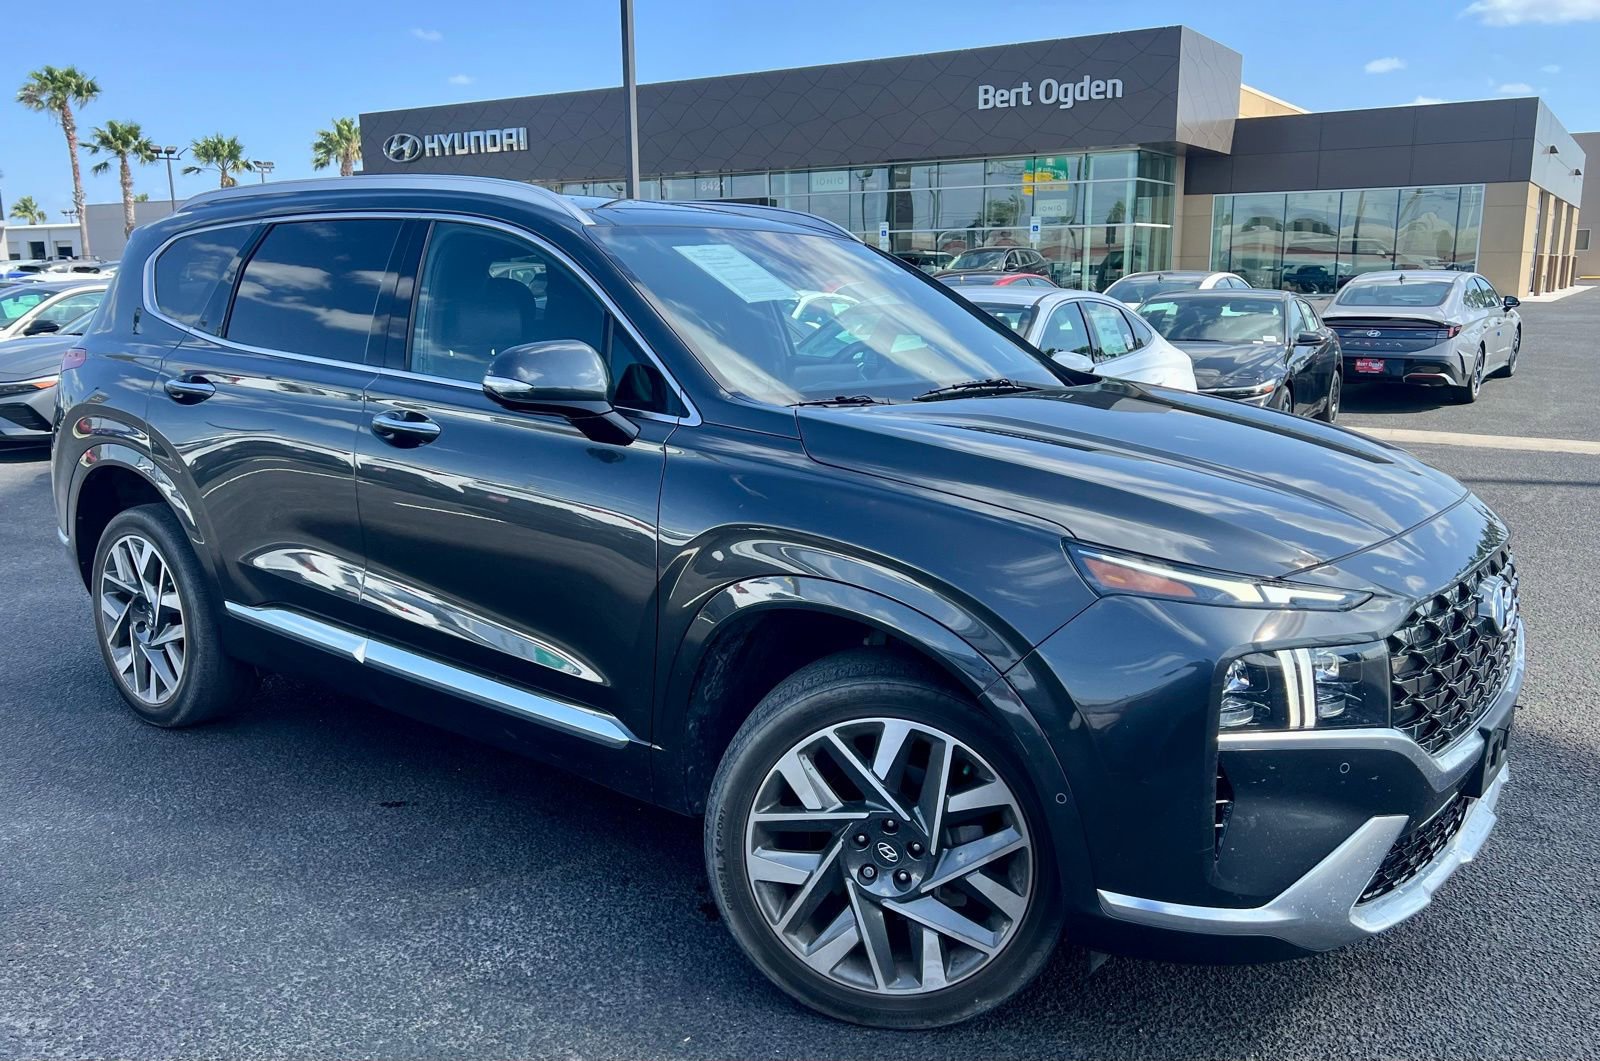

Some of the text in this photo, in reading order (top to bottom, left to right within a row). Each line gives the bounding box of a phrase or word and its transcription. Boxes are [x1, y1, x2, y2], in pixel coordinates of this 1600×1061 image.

[978, 75, 1123, 110] Bert Ogden
[424, 127, 529, 157] HYUNDAI
